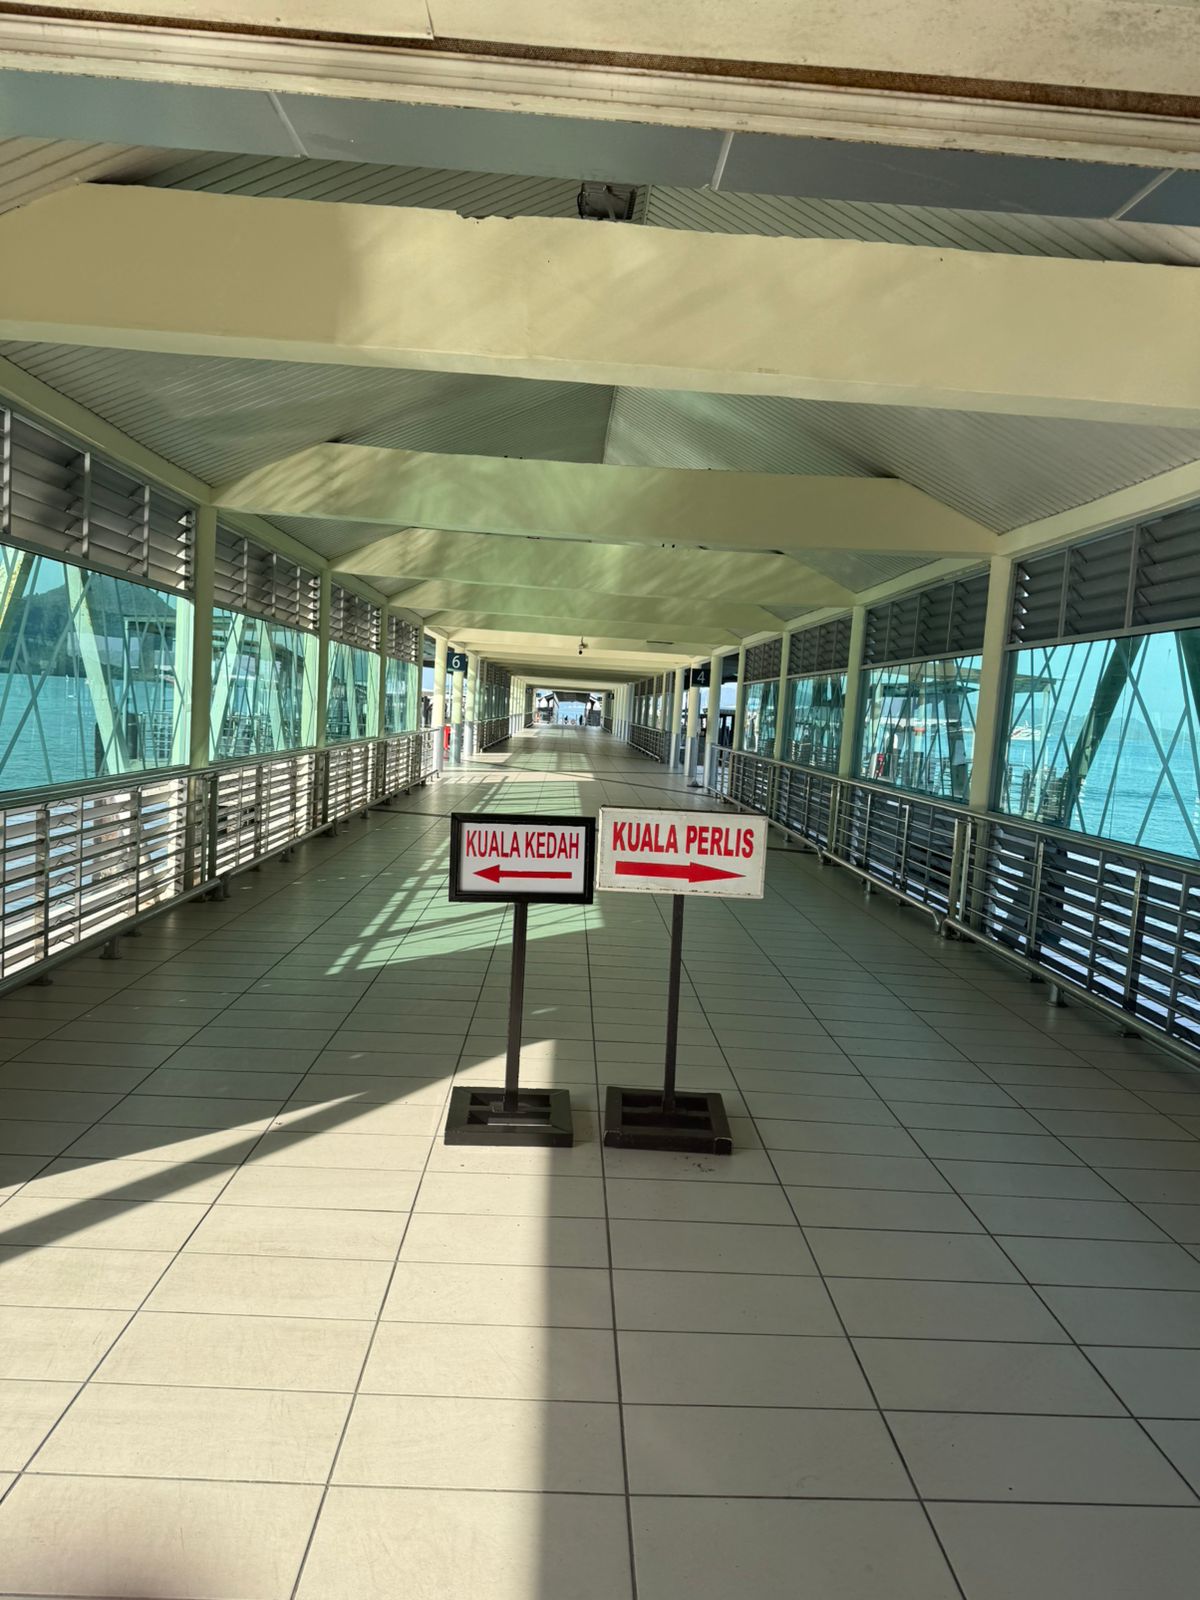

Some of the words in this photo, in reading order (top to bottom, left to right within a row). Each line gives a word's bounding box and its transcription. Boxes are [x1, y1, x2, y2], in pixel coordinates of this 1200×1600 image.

[452, 655, 461, 669] 6
[697, 670, 705, 684] 4
[466, 830, 521, 858] KUALA
[523, 831, 579, 859] KEDAH
[612, 821, 678, 854] KUALA
[685, 825, 755, 859] PERLIS
